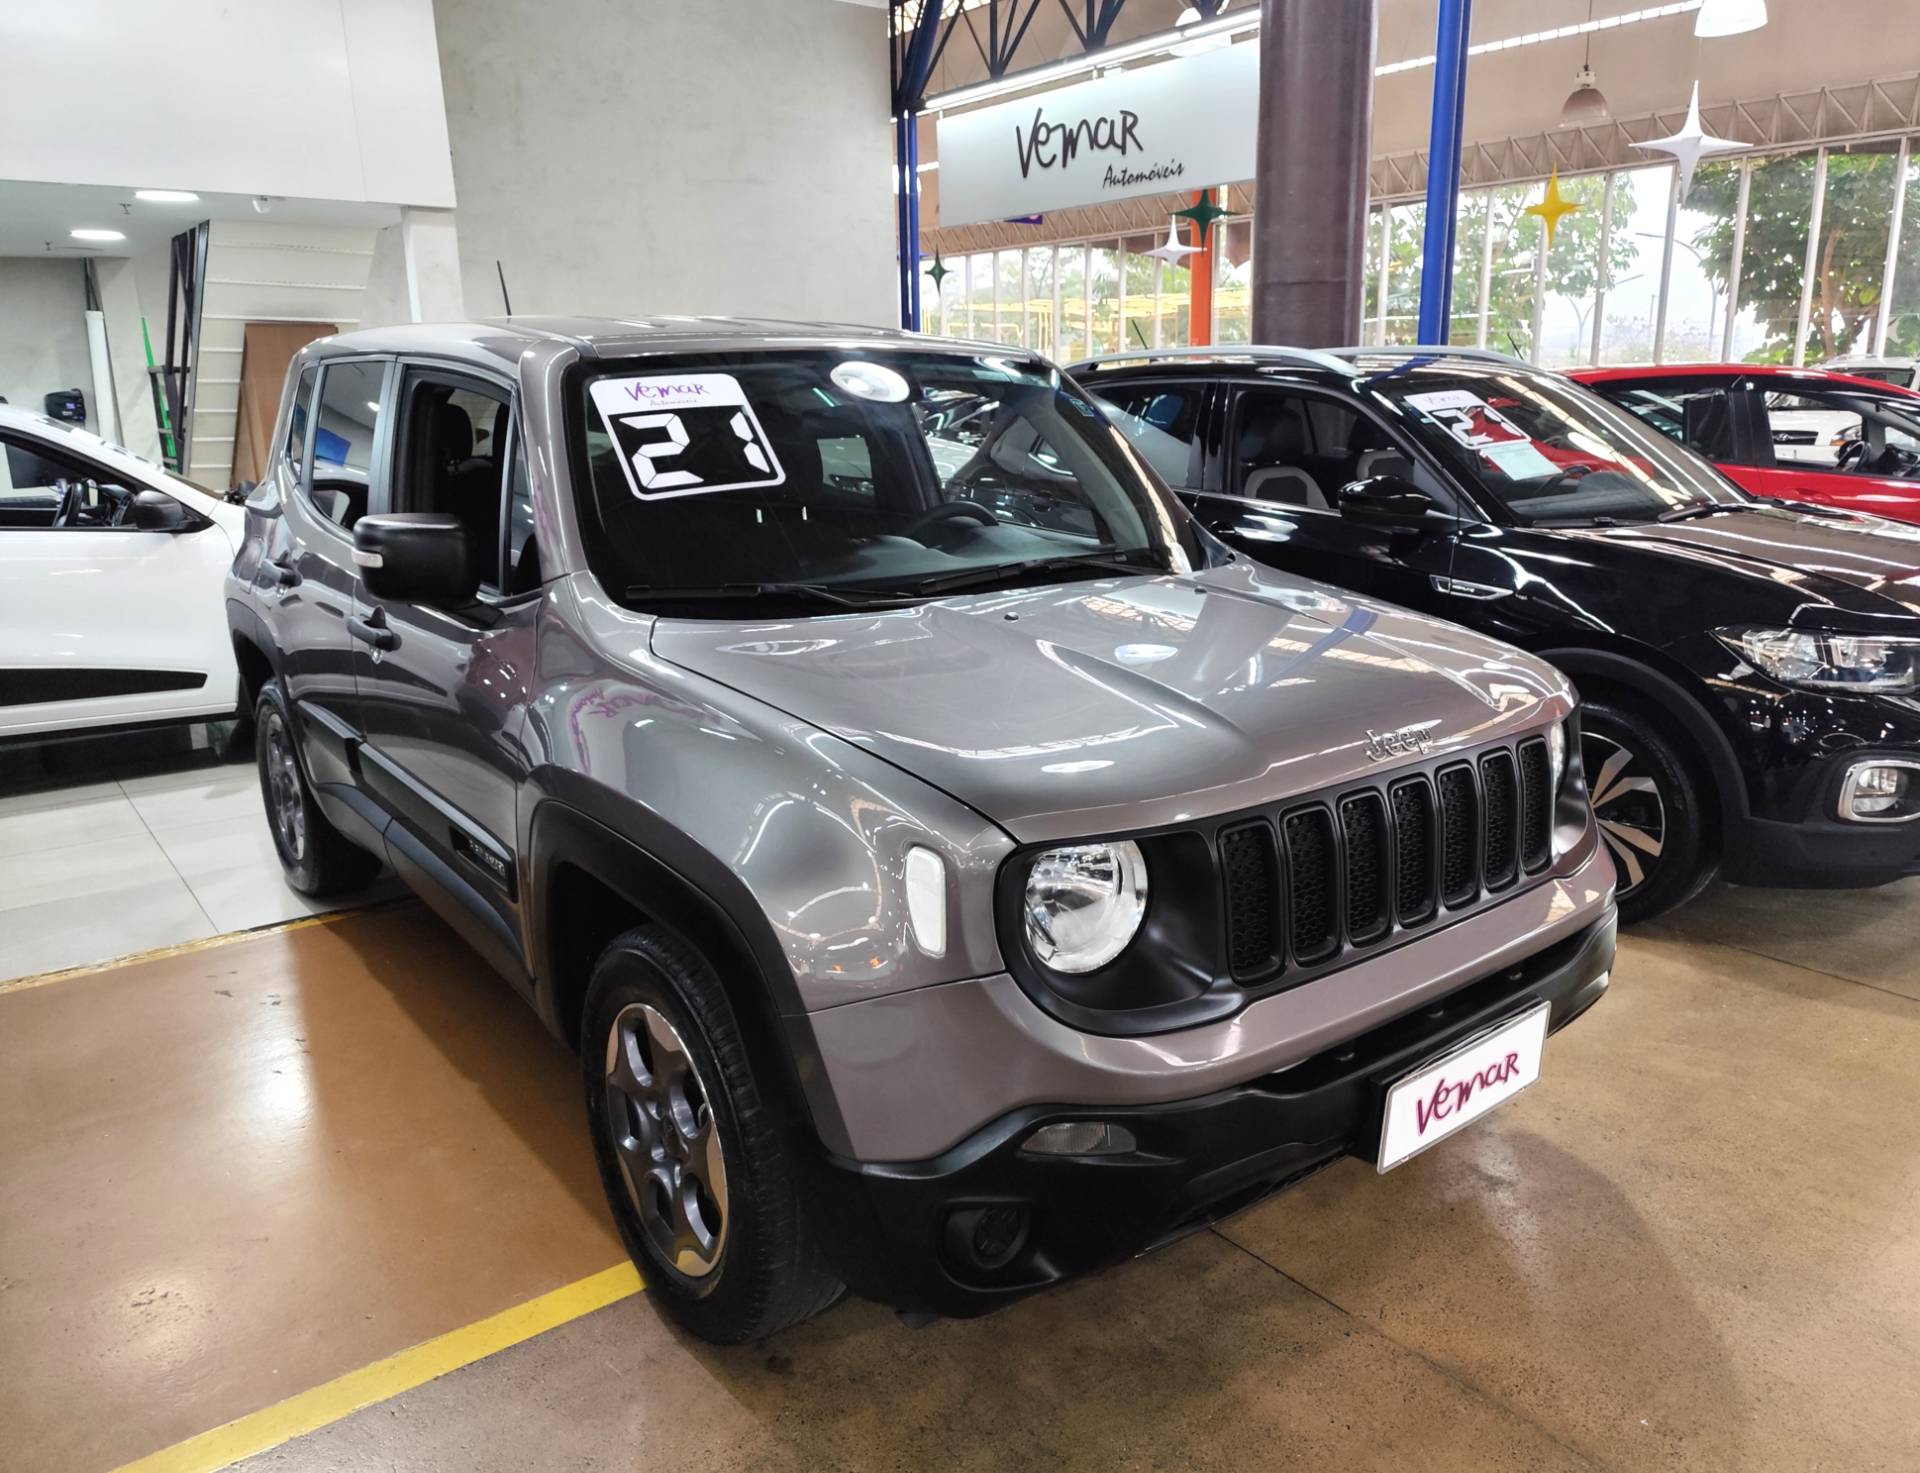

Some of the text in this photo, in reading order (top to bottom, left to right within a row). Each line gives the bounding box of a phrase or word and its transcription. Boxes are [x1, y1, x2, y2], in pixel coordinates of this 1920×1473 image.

[1102, 158, 1185, 189] Automóveis
[619, 411, 771, 489] 21
[1365, 724, 1434, 760] Jeep
